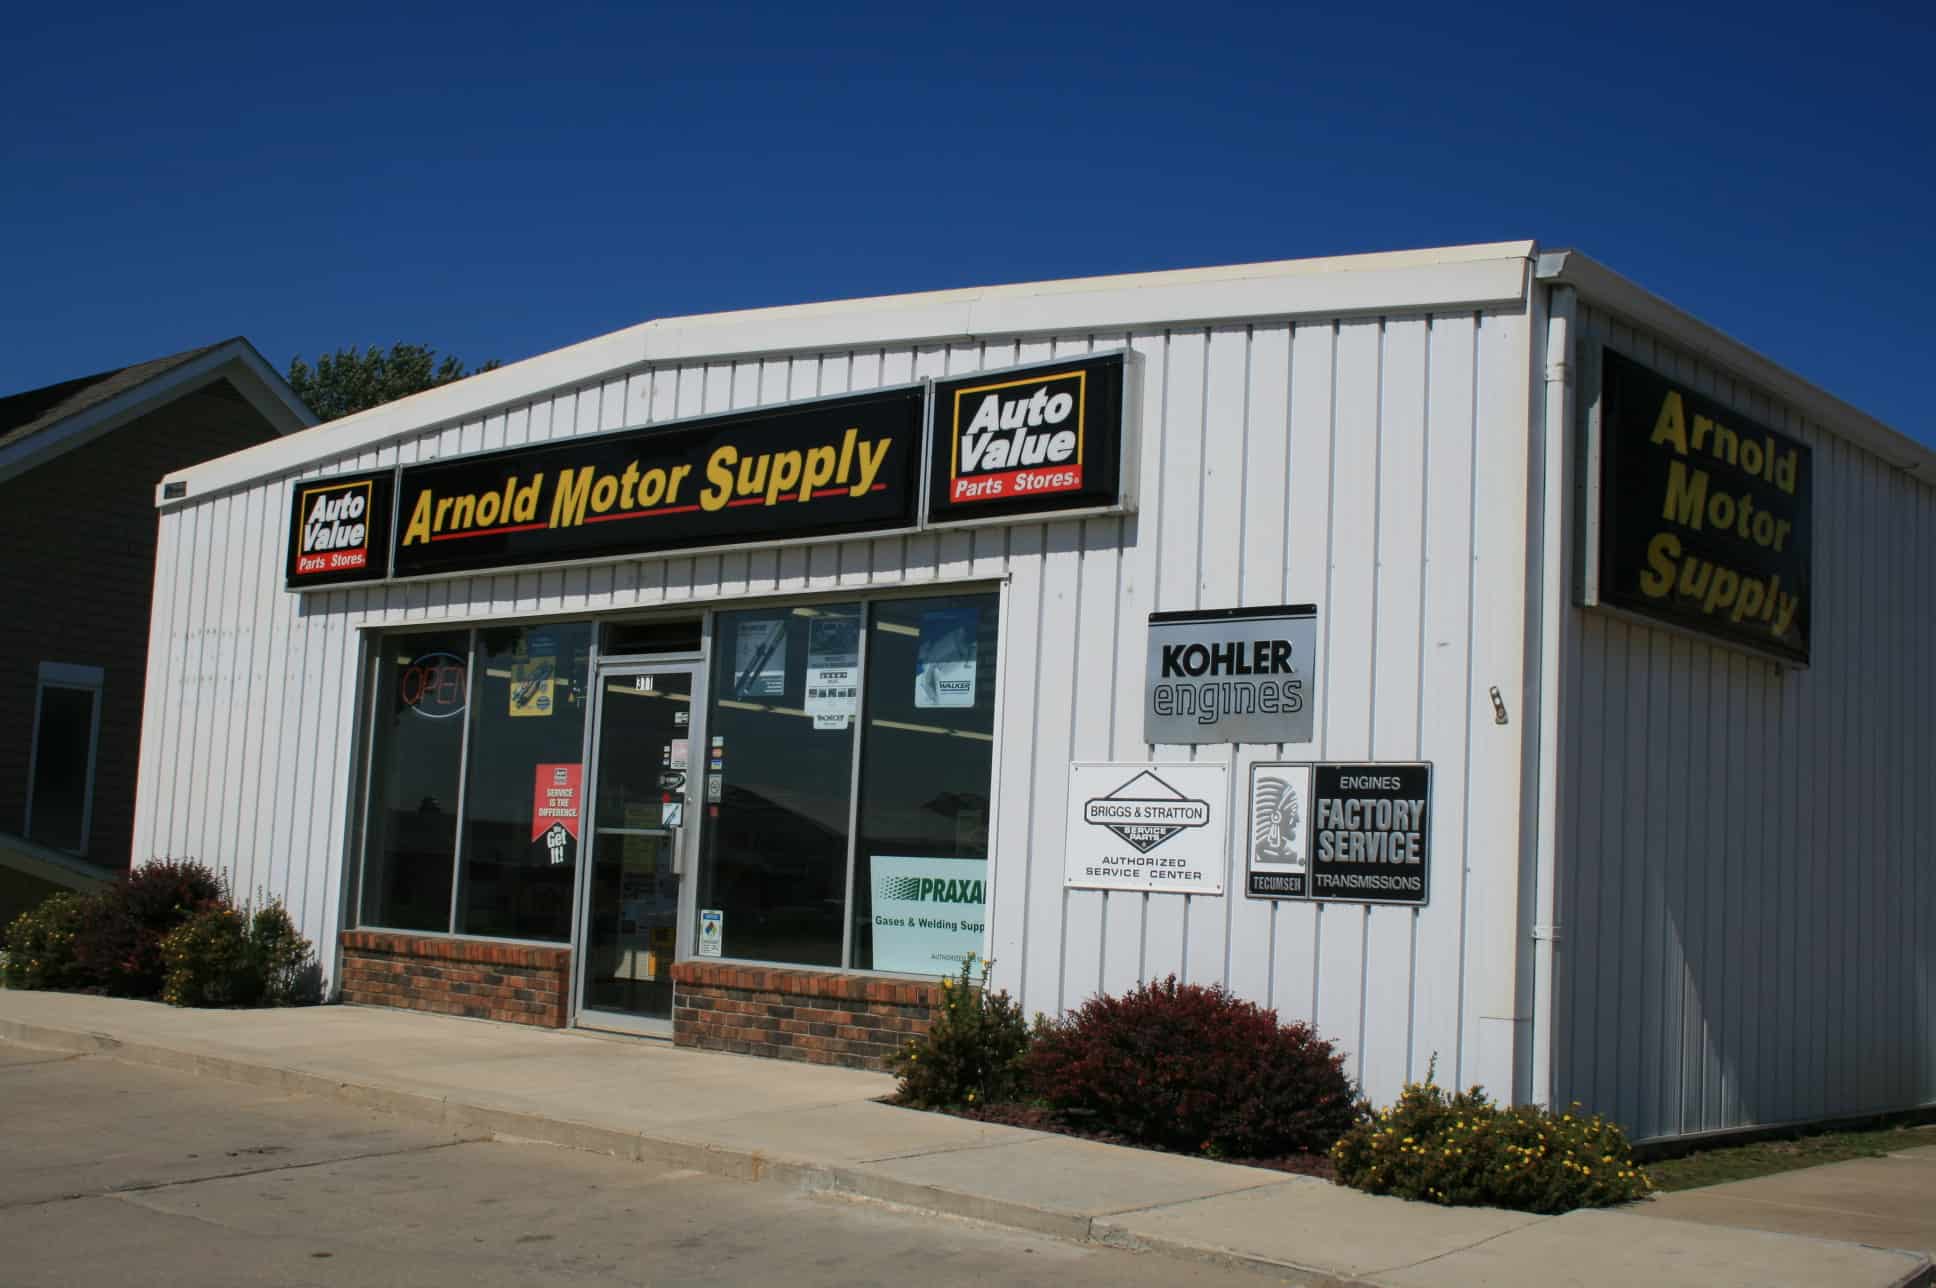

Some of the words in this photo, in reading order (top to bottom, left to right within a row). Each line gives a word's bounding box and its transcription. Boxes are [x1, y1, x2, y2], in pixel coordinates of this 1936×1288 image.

[966, 386, 1073, 435] Auto
[961, 427, 1076, 473] Value
[1651, 391, 1797, 494] Arnold
[402, 473, 541, 546] Arnold
[548, 459, 692, 529] Motor
[699, 427, 892, 511] Supply
[955, 478, 1003, 499] Parts
[308, 490, 366, 525] Auto
[1663, 460, 1792, 552] Motor
[303, 520, 366, 552] Value
[300, 557, 326, 570] Parts
[1639, 532, 1799, 638] Supply
[1161, 639, 1295, 678] KOHLER
[1153, 680, 1303, 724] engines
[1340, 776, 1401, 791] ENGINES
[1090, 806, 1132, 818] BRIGGS
[1134, 807, 1141, 817] &
[1144, 806, 1202, 819] STRATTON
[1317, 799, 1424, 831] FACTORY
[547, 828, 566, 848] Get
[1318, 831, 1421, 864] SERVICE
[1086, 867, 1140, 878] SERVICE
[1149, 869, 1202, 880] CENTER
[1102, 856, 1186, 867] AUTHORIZED
[920, 878, 987, 904] PRAXA
[1316, 874, 1421, 890] TRANSMISSIONS
[875, 916, 905, 927] Gases
[908, 917, 915, 927] &
[919, 918, 958, 932] Welding
